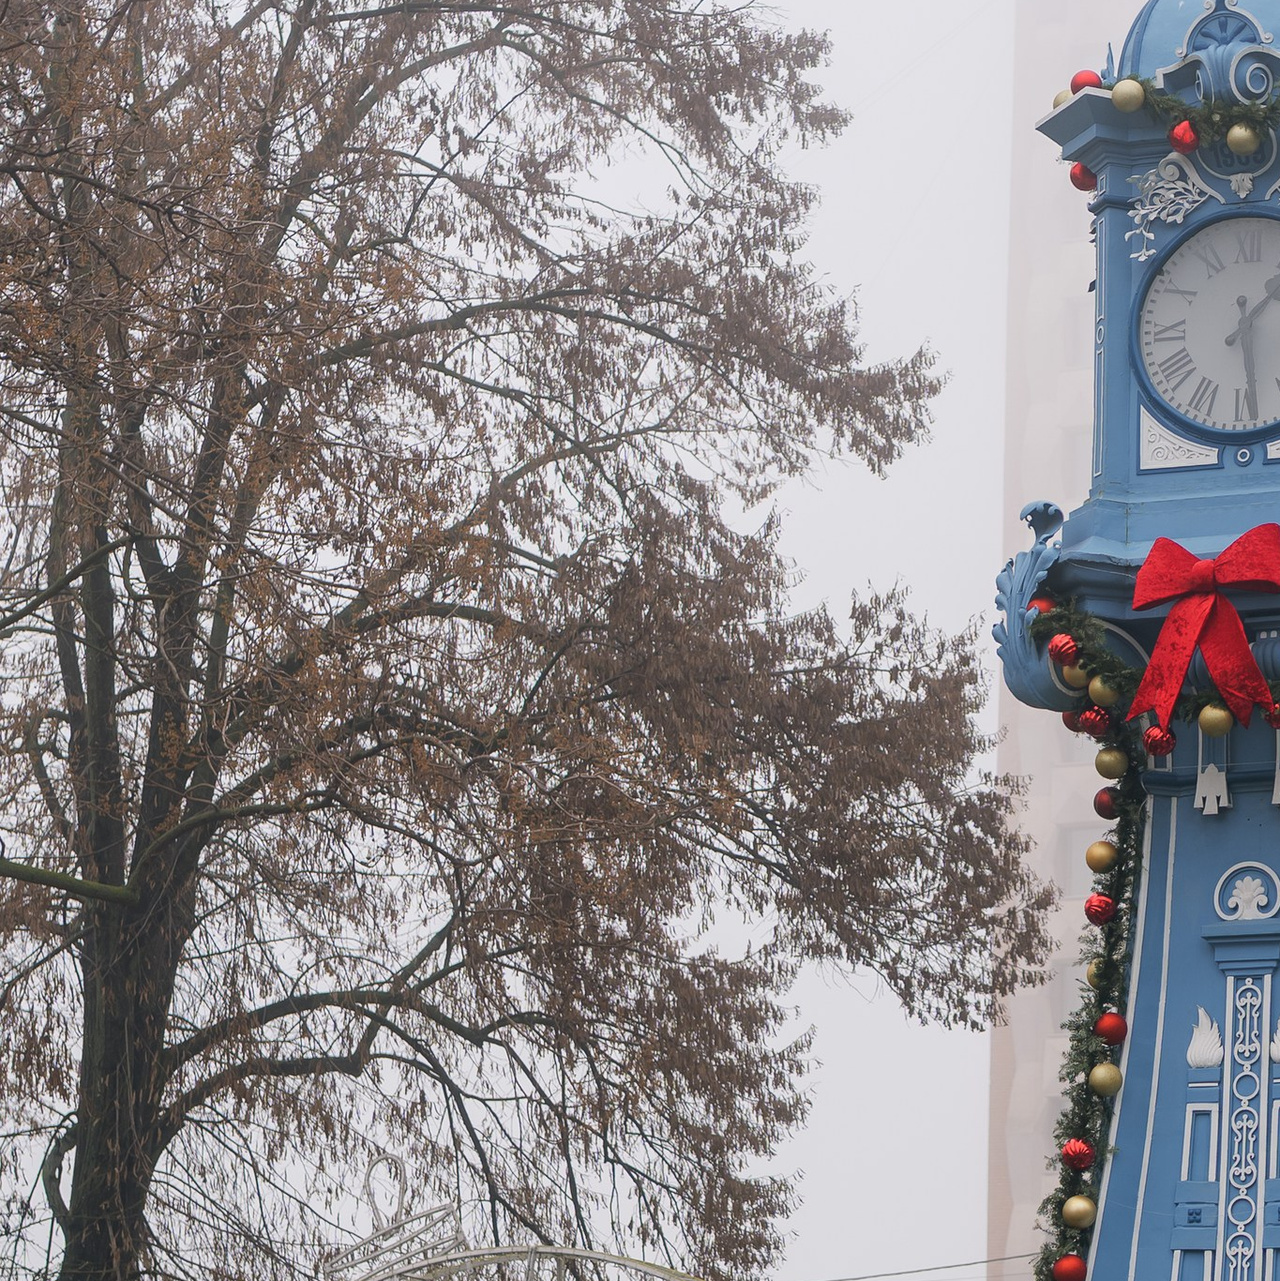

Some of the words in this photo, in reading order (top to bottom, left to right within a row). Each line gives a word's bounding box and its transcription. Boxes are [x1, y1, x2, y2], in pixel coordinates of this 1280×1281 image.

[1194, 241, 1226, 280] XI
[1233, 231, 1263, 264] XII
[1163, 277, 1198, 306] X
[1153, 318, 1186, 344] IX
[1157, 346, 1197, 394] VIII
[1187, 376, 1219, 418] VII
